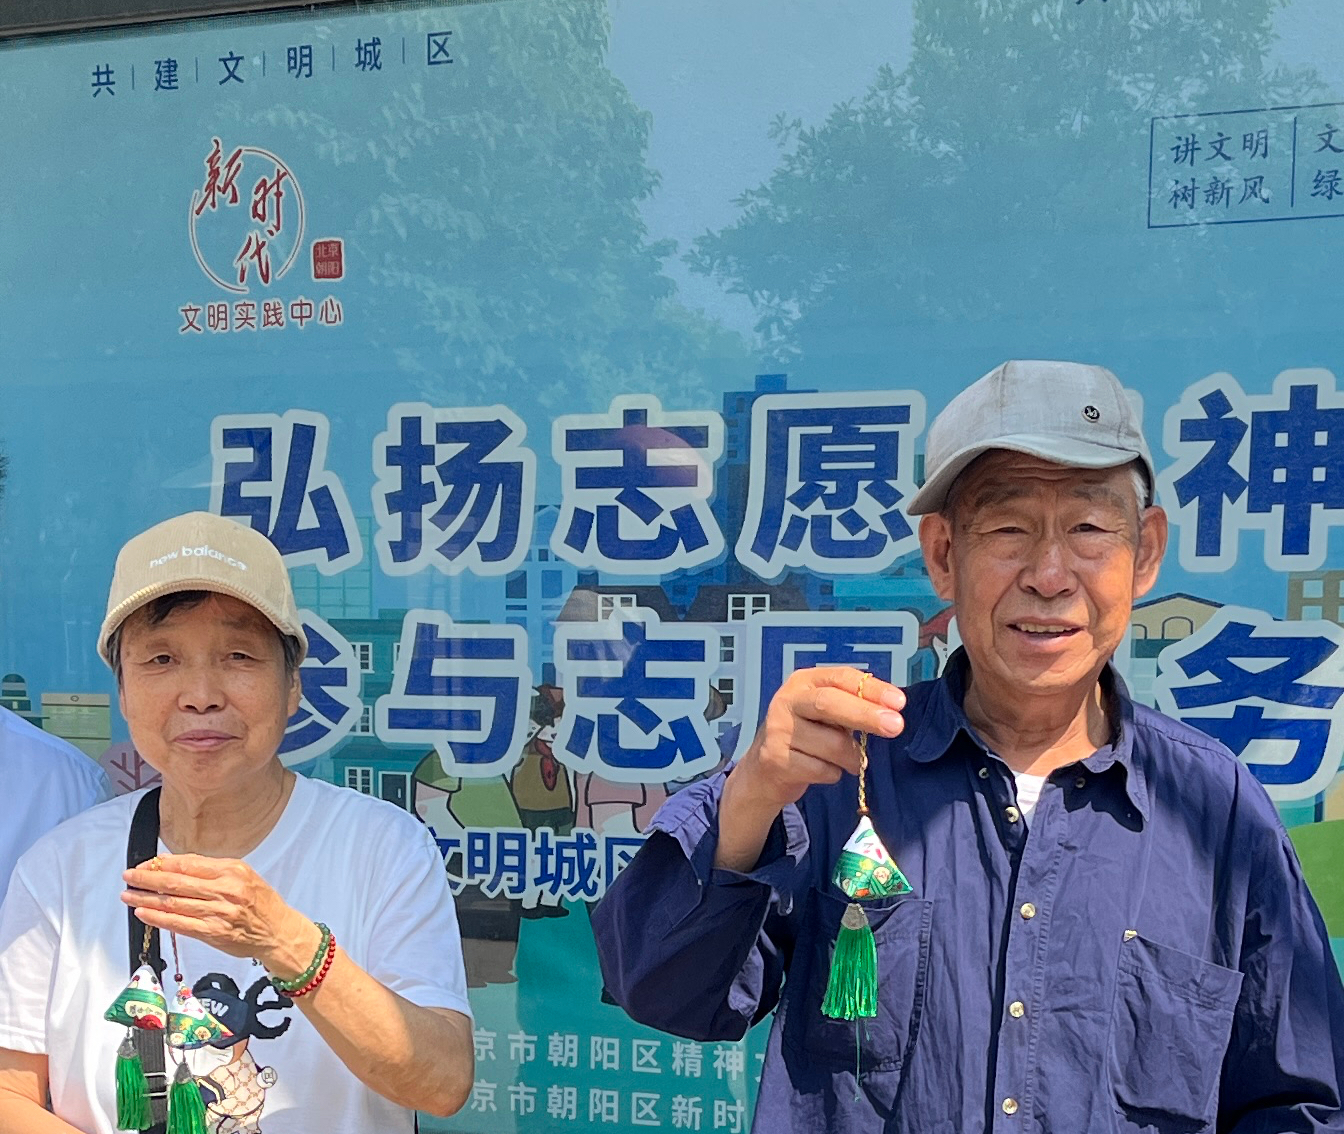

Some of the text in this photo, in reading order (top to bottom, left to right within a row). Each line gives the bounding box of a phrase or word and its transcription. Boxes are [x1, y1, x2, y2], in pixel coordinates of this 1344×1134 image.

[1170, 129, 1269, 166] 讲文明
[1168, 175, 1270, 210] 树新风
[180, 298, 342, 333] 文明实践中心
[150, 545, 248, 571] new balance
